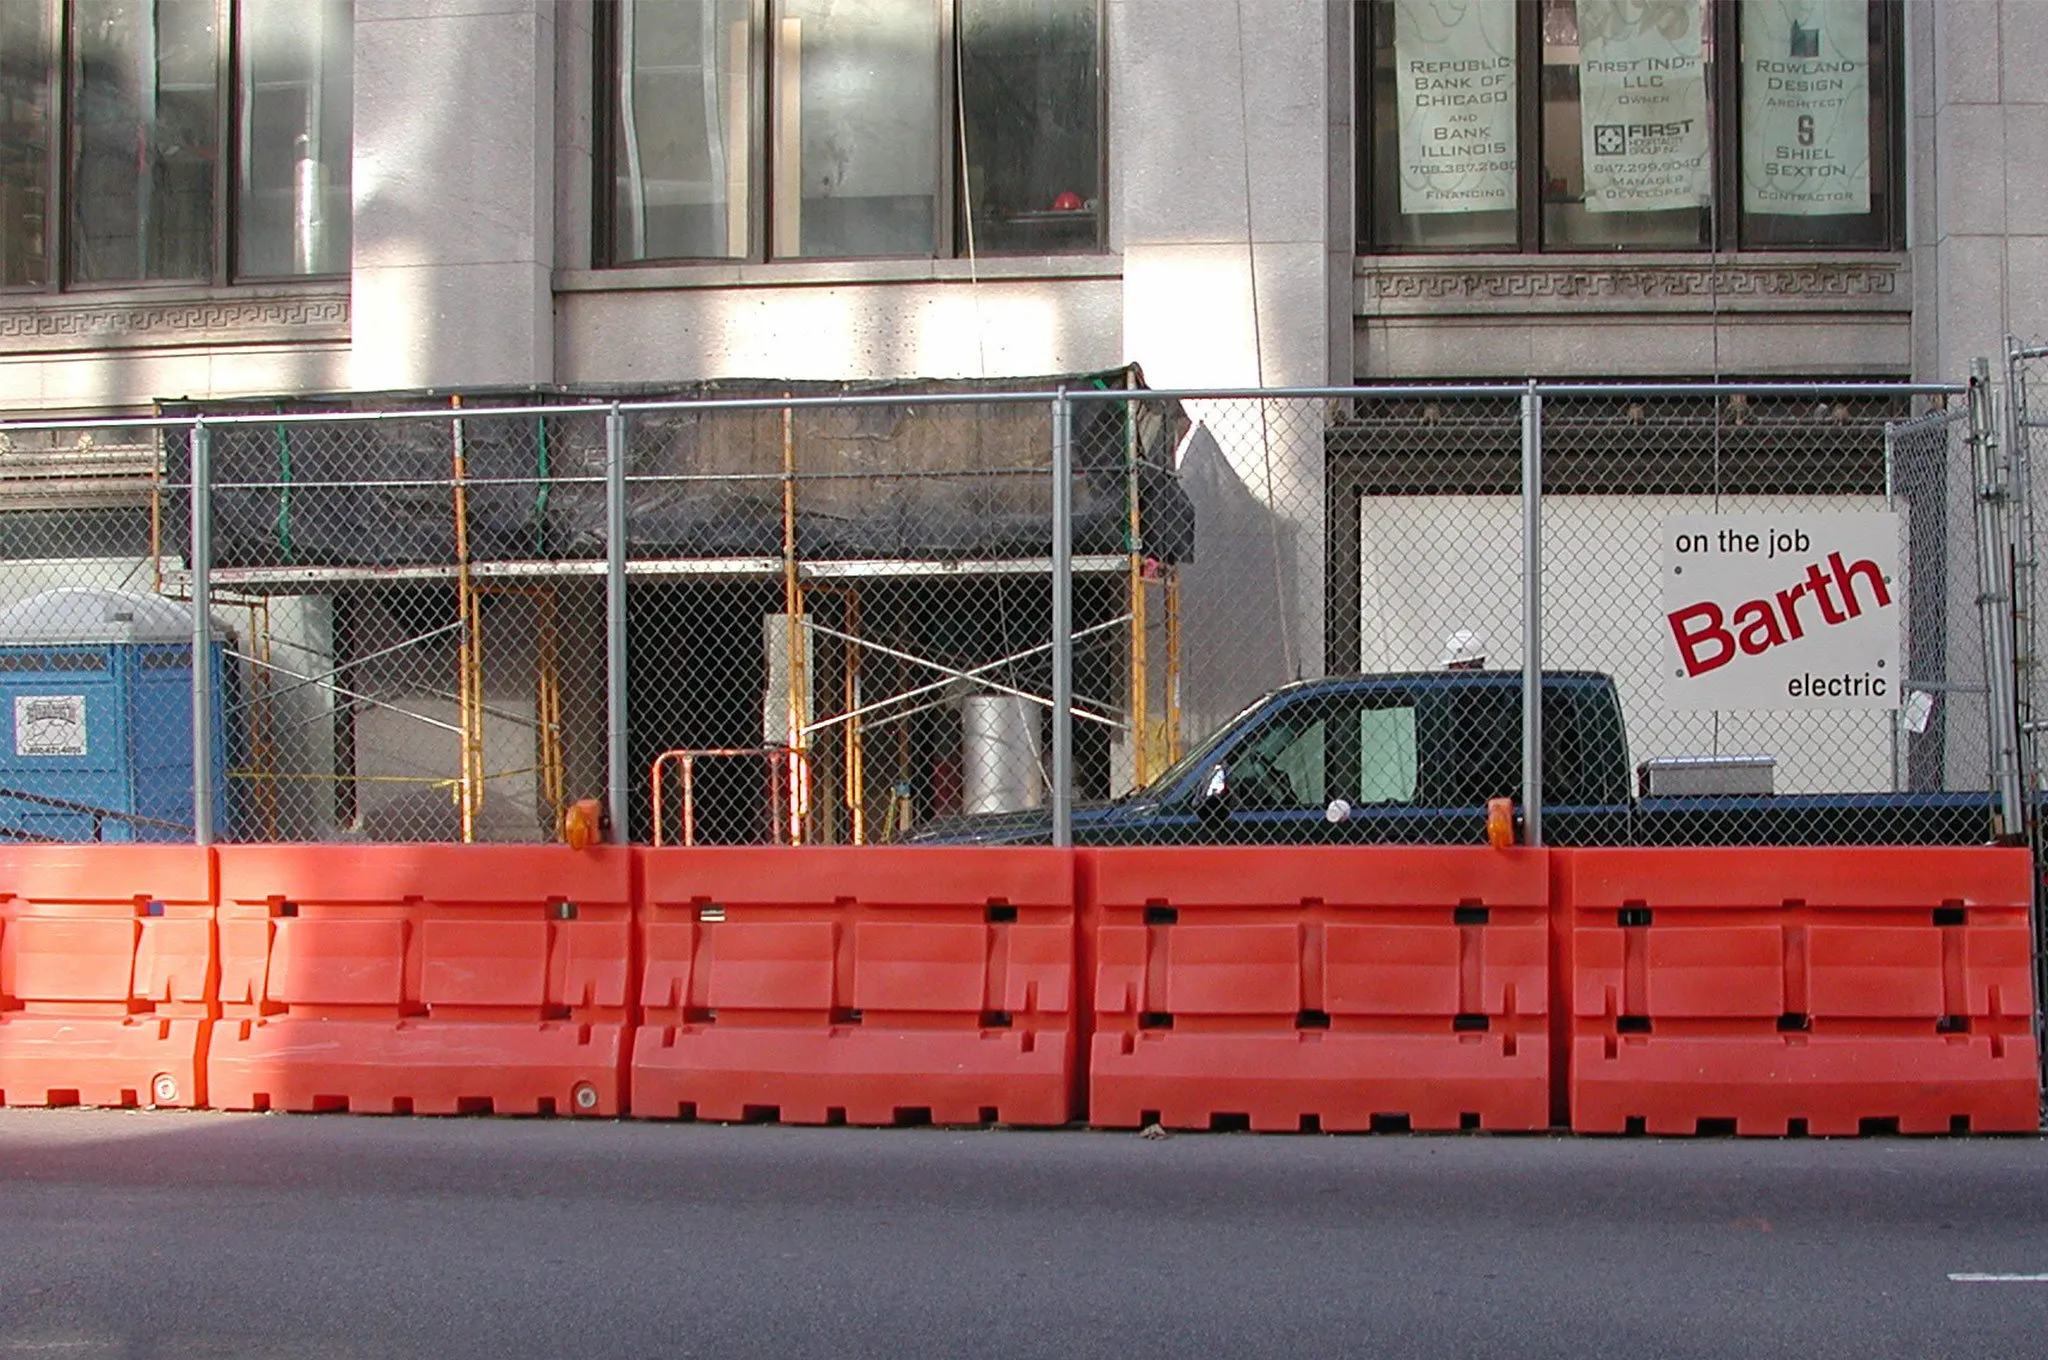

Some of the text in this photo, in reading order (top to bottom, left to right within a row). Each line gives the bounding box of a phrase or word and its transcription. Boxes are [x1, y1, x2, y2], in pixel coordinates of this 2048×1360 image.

[1410, 57, 1510, 73] REPUBLIC
[1587, 60, 1639, 73] FIRST
[1756, 60, 1855, 75] ROWLAND
[1415, 74, 1506, 90] BANK OF
[1623, 75, 1664, 88] LLC
[1768, 78, 1843, 91] DESIGN
[1416, 91, 1508, 107] CHICAGO
[1618, 95, 1669, 105] OWNER
[1766, 97, 1844, 108] ARCHITECT
[1434, 127, 1492, 140] BANK
[1628, 119, 1694, 138] FIRST
[1421, 143, 1506, 158] ILLINOIS
[1776, 146, 1835, 160] SHIEL
[1766, 163, 1847, 177] SEXTON
[1425, 188, 1506, 200] FINANCING
[1758, 189, 1854, 202] CONTRACTOR
[1675, 529, 1810, 559] on the job
[1667, 551, 1892, 678] Barth
[1788, 673, 1887, 697] electric
